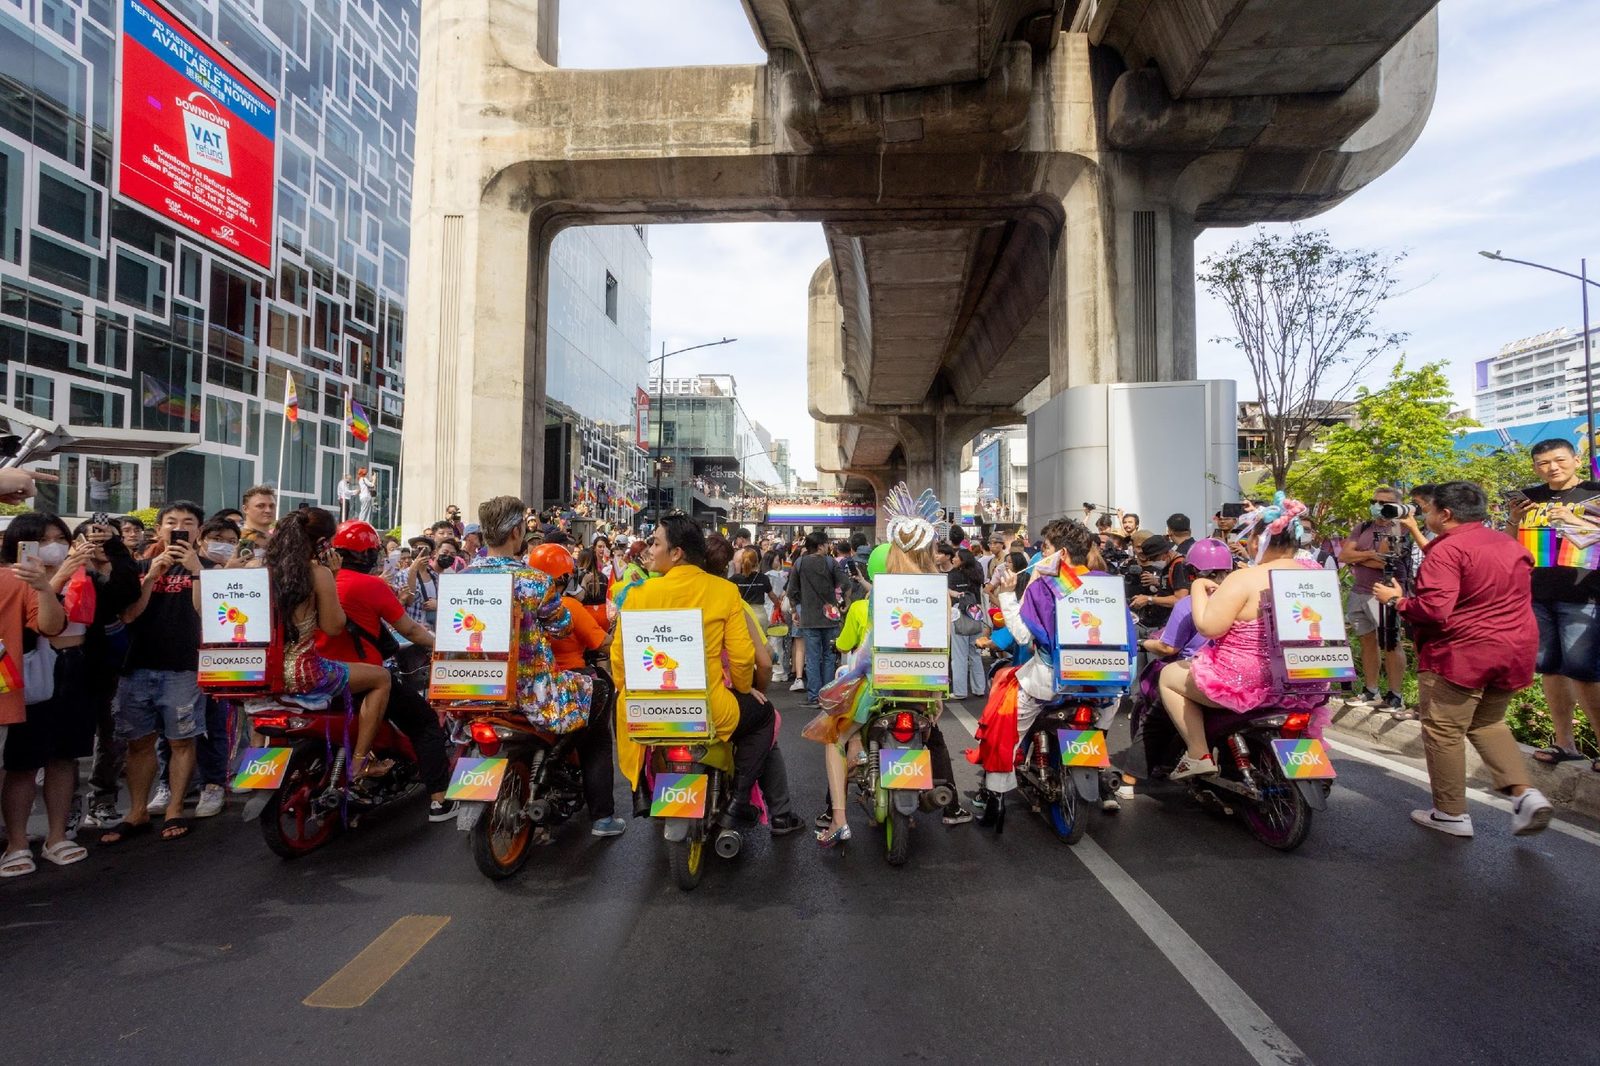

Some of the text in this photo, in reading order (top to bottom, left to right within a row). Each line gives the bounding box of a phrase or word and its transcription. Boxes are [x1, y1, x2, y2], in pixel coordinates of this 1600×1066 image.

[131, 1, 164, 32] REFUND
[166, 28, 194, 57] FASTER
[199, 55, 212, 68] GET
[213, 66, 232, 85] CASH
[232, 79, 271, 115] IMMEDIATELY
[152, 29, 258, 116] AVAILABLE NOW!!
[175, 96, 230, 129] DOWNTOWN
[191, 123, 221, 149] VAT
[195, 143, 223, 160] refund
[153, 144, 191, 171] Downtown
[192, 167, 202, 178] Vat
[203, 175, 225, 192] Refund
[142, 154, 161, 171] Siam
[207, 193, 217, 204] 1st
[227, 204, 239, 216] and
[158, 155, 191, 180] Inspector
[195, 177, 225, 201] Customer
[226, 196, 247, 214] Service
[173, 181, 190, 196] Siam
[225, 211, 234, 220] GF
[649, 378, 702, 394] ENTER
[827, 506, 875, 517] FREEDO
[227, 582, 243, 590] Ads
[1298, 582, 1314, 590] Ads
[212, 591, 261, 600] On-The-Go
[466, 588, 484, 596] Ads
[902, 587, 920, 596] Ads
[1082, 588, 1099, 596] Ads
[1285, 591, 1332, 599] On-The-Go
[450, 597, 503, 606] On-The-Go
[886, 596, 939, 605] On-The-Go
[1068, 596, 1117, 604] On-The-Go
[653, 624, 672, 633] Ads
[635, 634, 694, 643] On-The-Go
[212, 656, 263, 665] LOOKADS.CO
[1074, 657, 1126, 666] LOOKADS.CO
[1299, 653, 1350, 663] LOOKADS.CO
[889, 660, 946, 669] LOOKADS.CO
[447, 669, 504, 678] LOOKADS.CO
[642, 706, 703, 716] LOOKADS.CO
[1066, 740, 1101, 756] look
[1285, 751, 1322, 766] look
[245, 759, 277, 776] look
[888, 760, 924, 777] look
[458, 770, 494, 787] look
[660, 786, 698, 805] look
